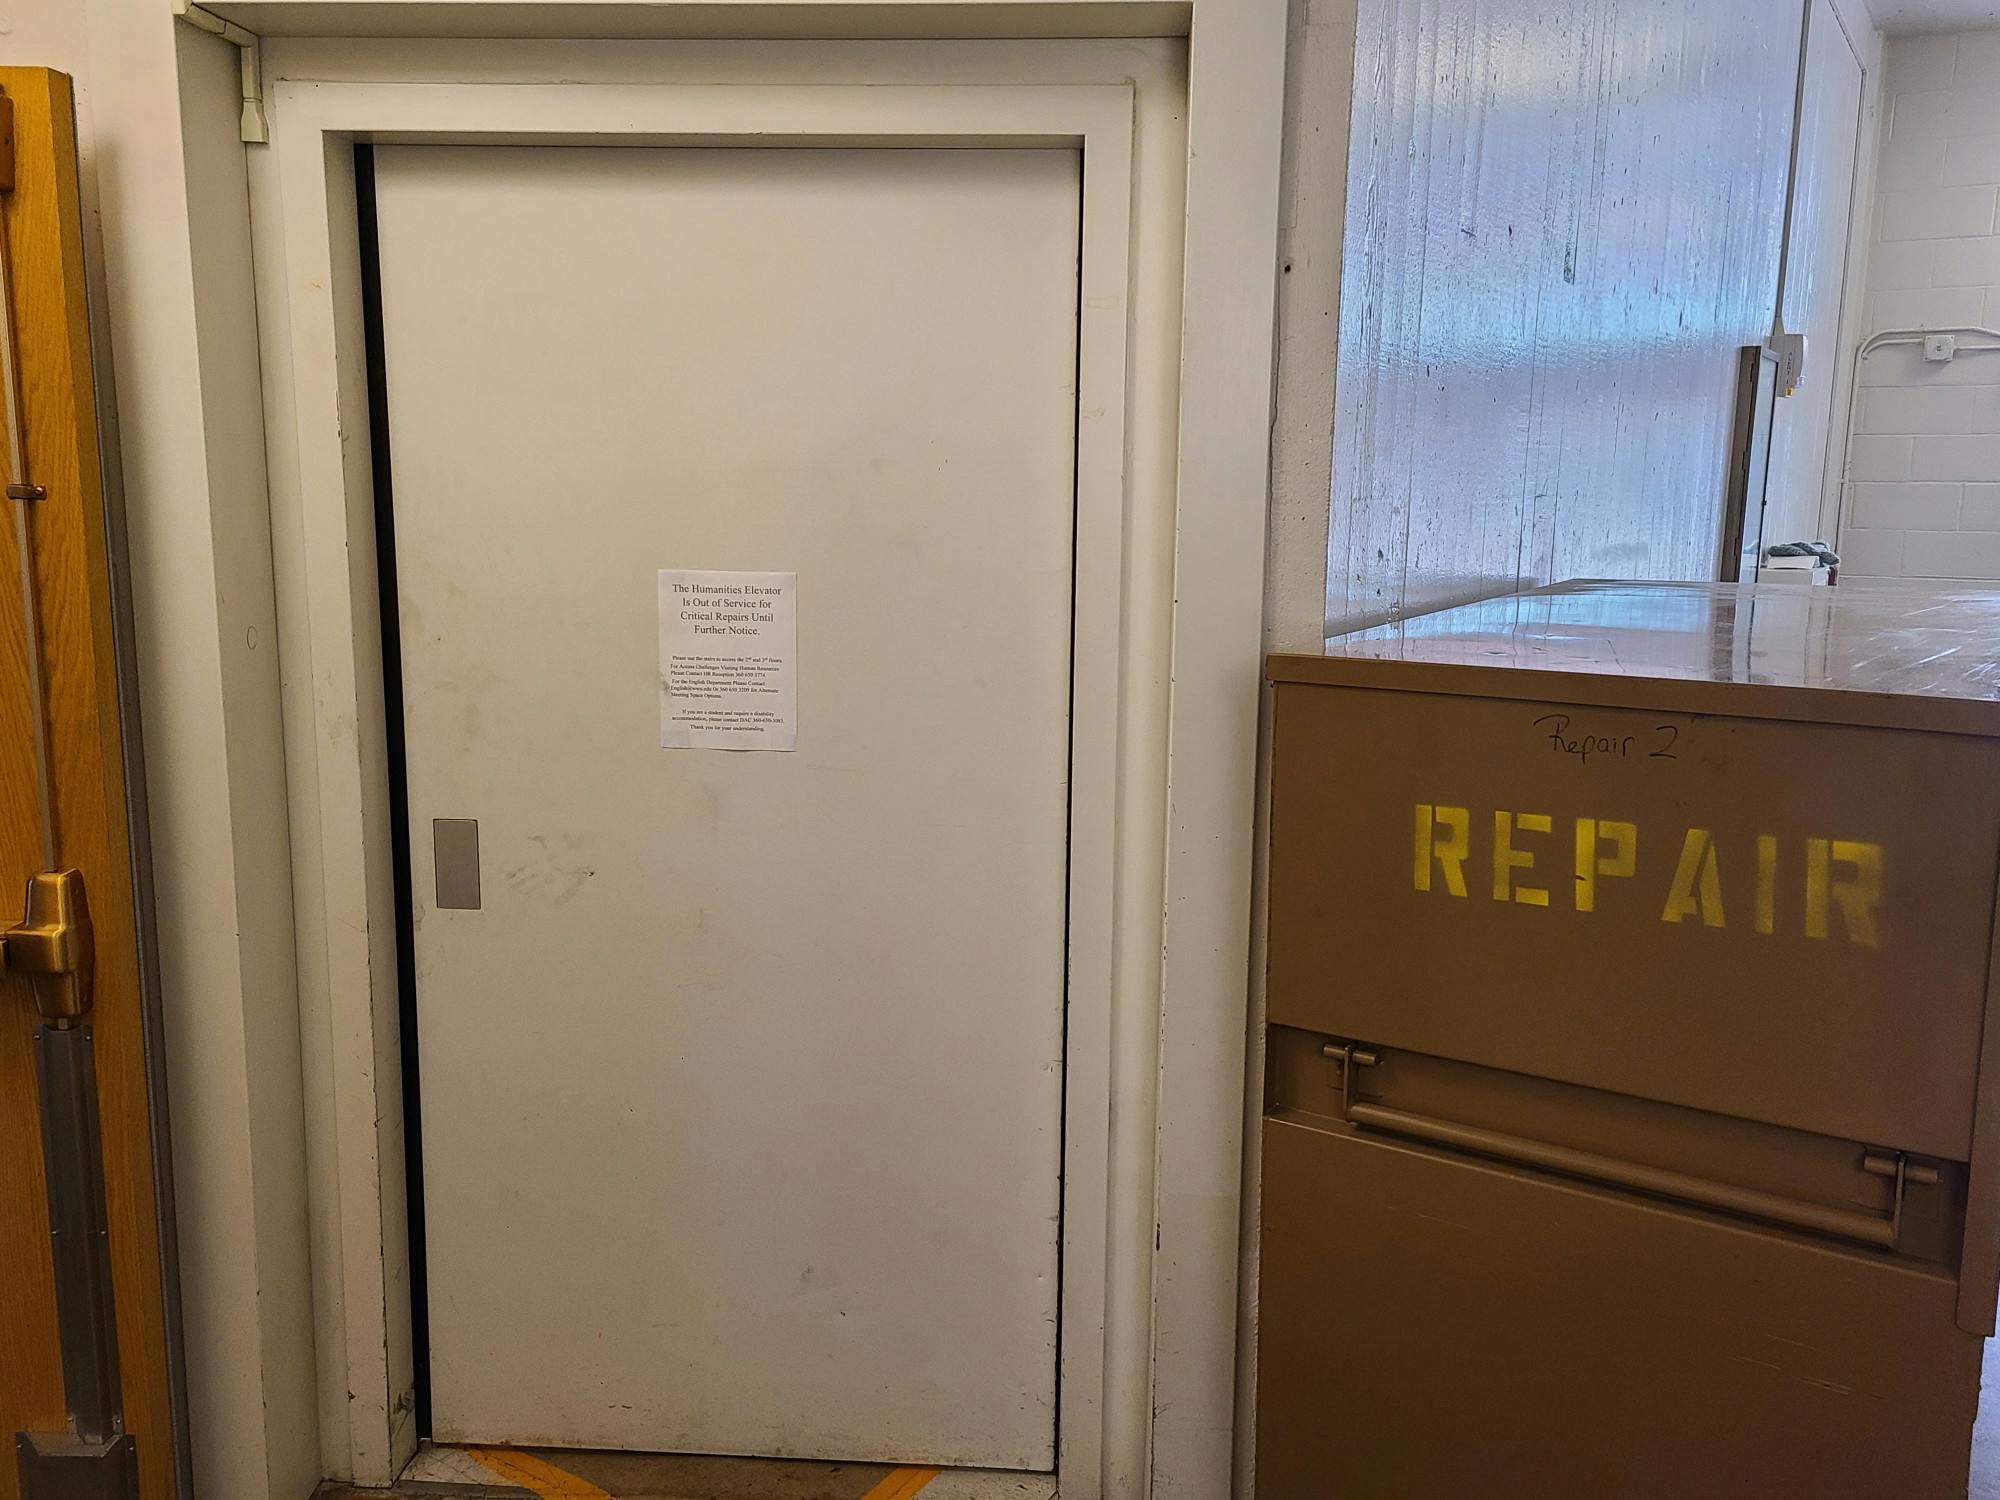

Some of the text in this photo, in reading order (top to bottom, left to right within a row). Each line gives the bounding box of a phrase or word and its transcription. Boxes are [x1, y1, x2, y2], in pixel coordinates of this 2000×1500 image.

[672, 584, 782, 595] The Humanities Elevator
[682, 598, 772, 608] Is Out of Service for
[680, 611, 774, 623] Critical Repairs Until
[694, 625, 760, 635] Further Notice.
[1533, 714, 1678, 764] Repair 2
[1414, 804, 1884, 949] REPAIR
